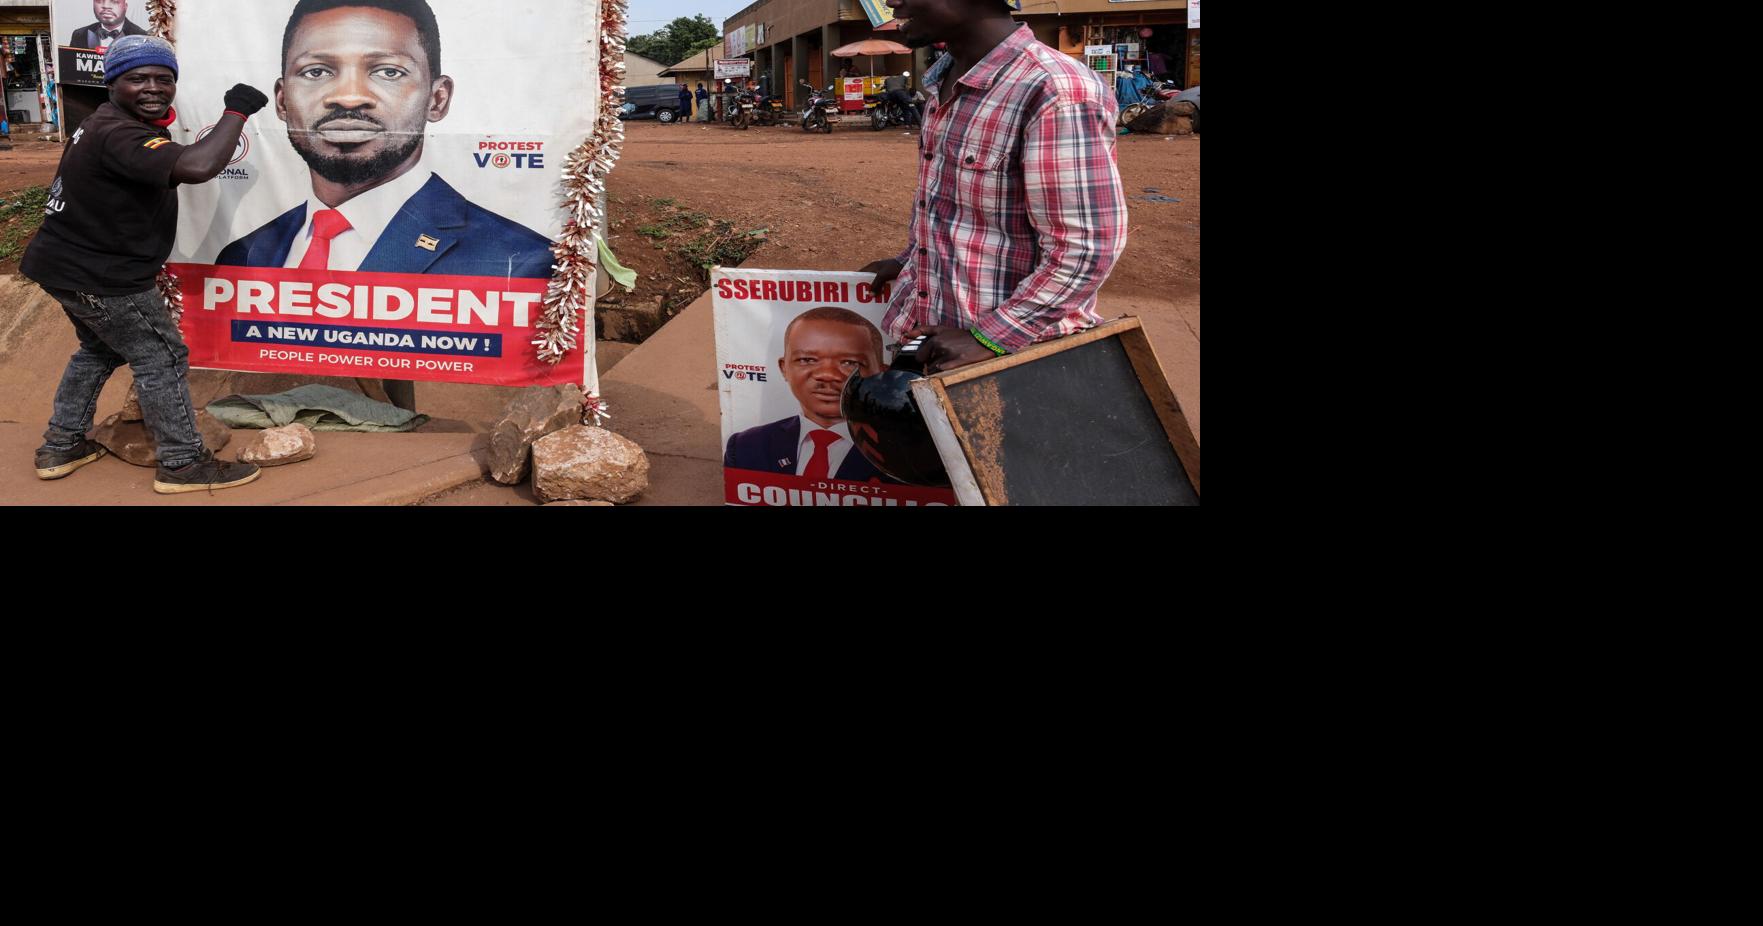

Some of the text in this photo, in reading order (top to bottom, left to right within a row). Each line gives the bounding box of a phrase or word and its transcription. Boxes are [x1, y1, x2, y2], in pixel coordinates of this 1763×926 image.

[479, 141, 544, 151] PROTEST
[473, 153, 544, 169] VOTE
[718, 278, 849, 303] SSERUBIRI
[203, 277, 542, 328] PRESIDENT
[246, 325, 262, 338] A
[268, 327, 318, 342] NEW
[324, 330, 415, 348] UGANDA
[421, 335, 478, 351] NOW
[259, 349, 474, 372] PEOPLE POWER OUR POWER
[725, 363, 766, 372] PROTEST
[722, 369, 768, 382] VOTE
